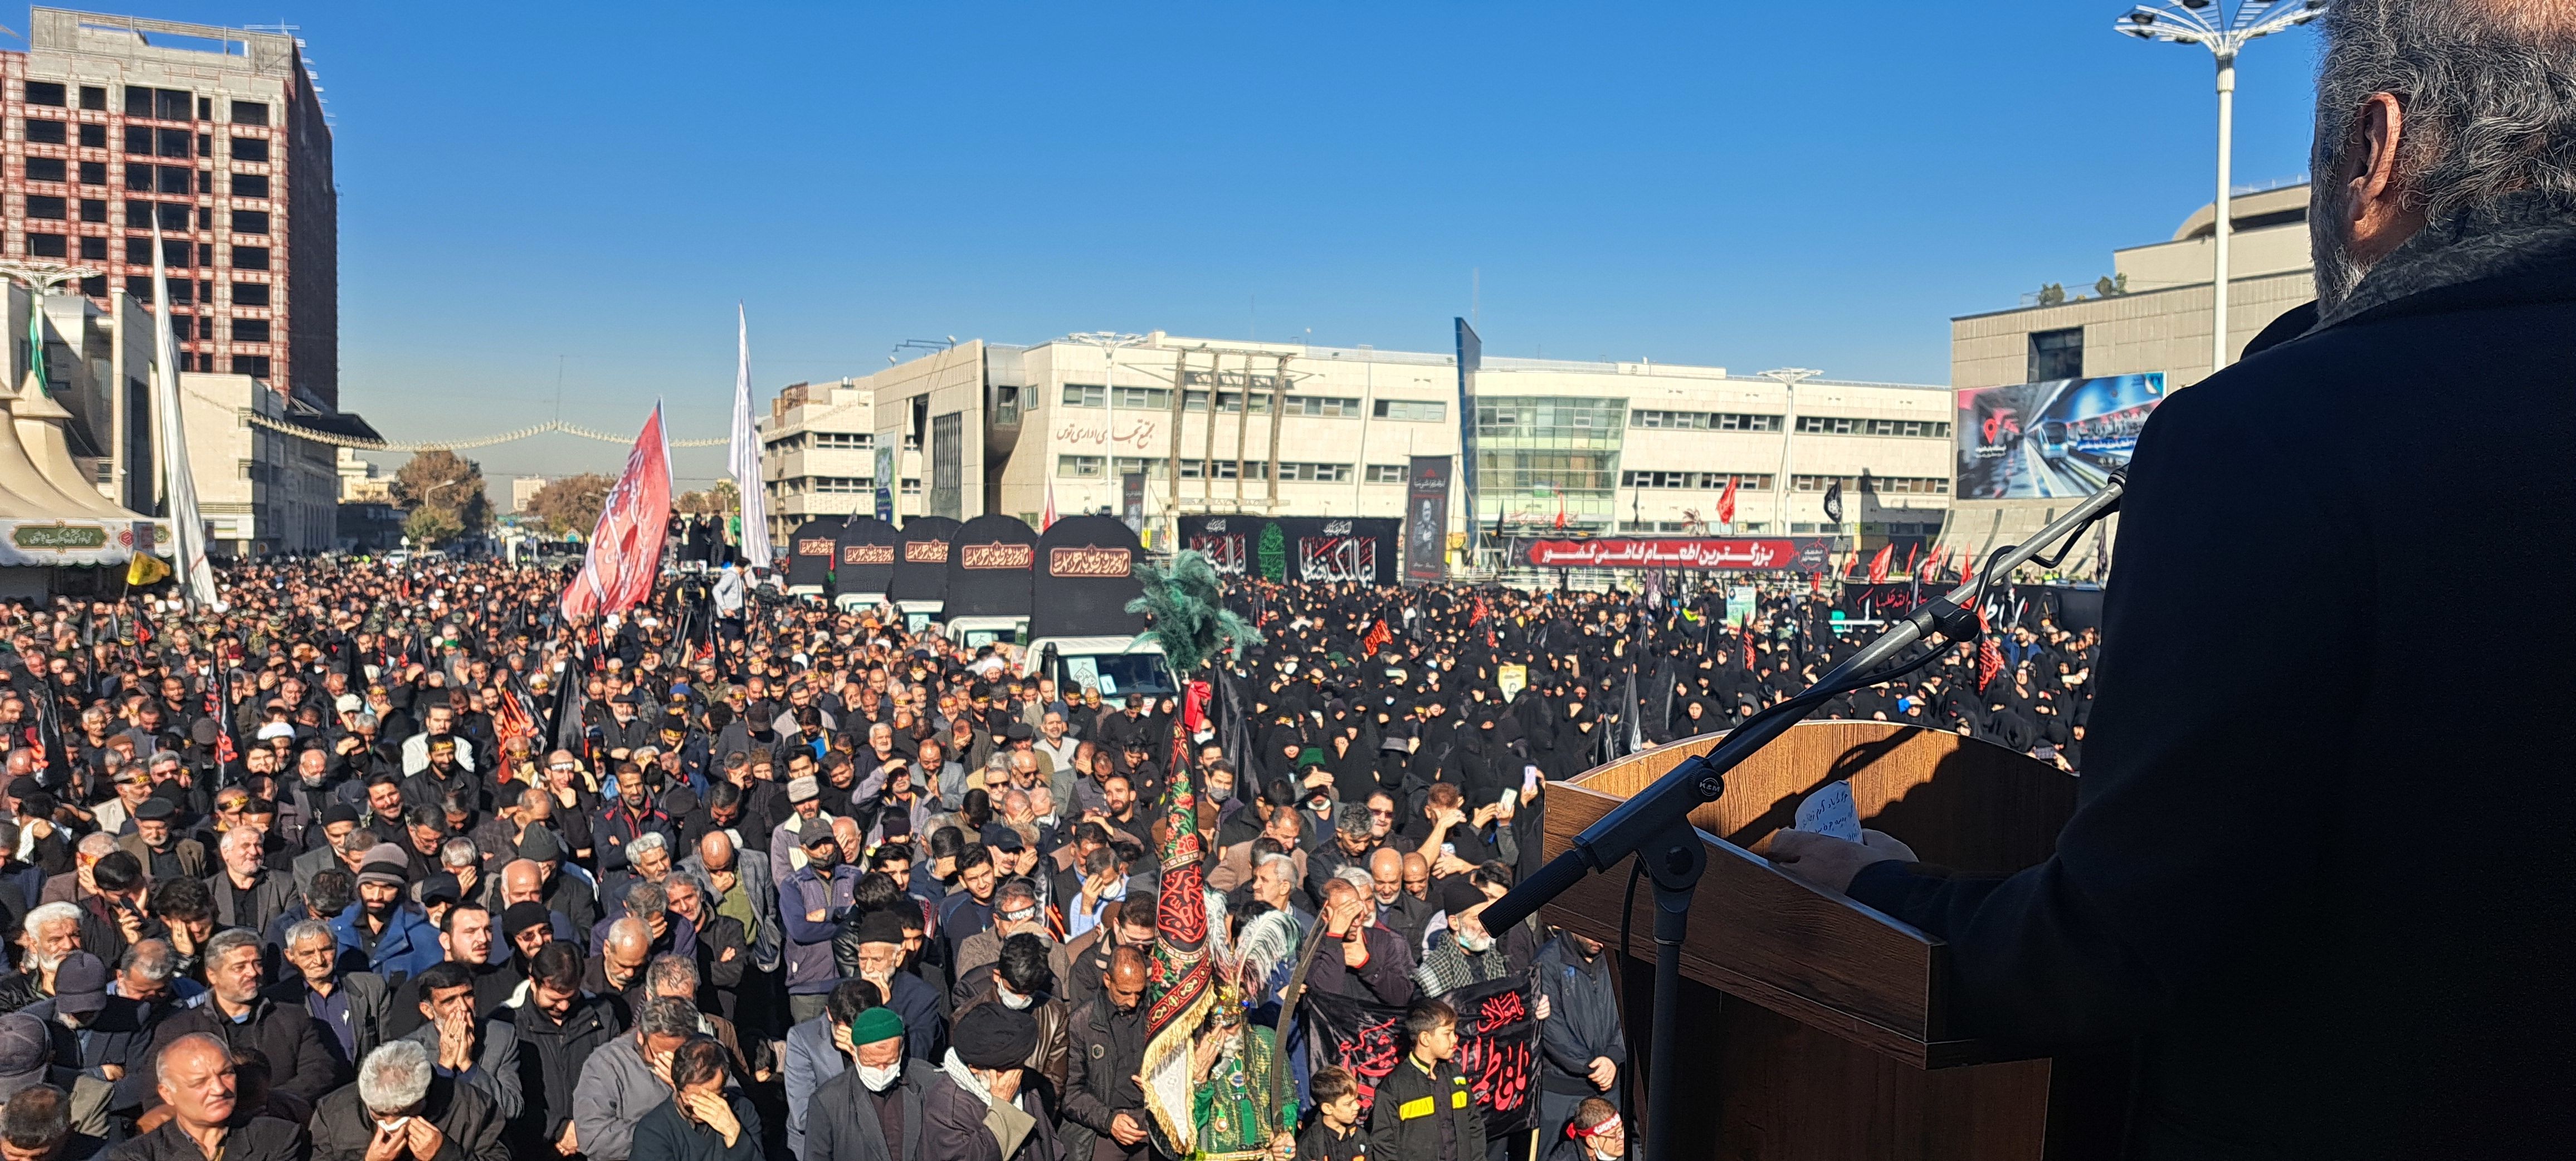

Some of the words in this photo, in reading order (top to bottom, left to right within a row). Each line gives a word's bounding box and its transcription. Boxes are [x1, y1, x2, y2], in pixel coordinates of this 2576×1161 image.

[1056, 423, 1075, 440] توس
[1070, 427, 1097, 443] اداری
[1542, 543, 1597, 563] کشور
[1595, 542, 1646, 564] فاطمی
[1644, 542, 1701, 565] اطعام
[1699, 782, 1720, 792] K&M
